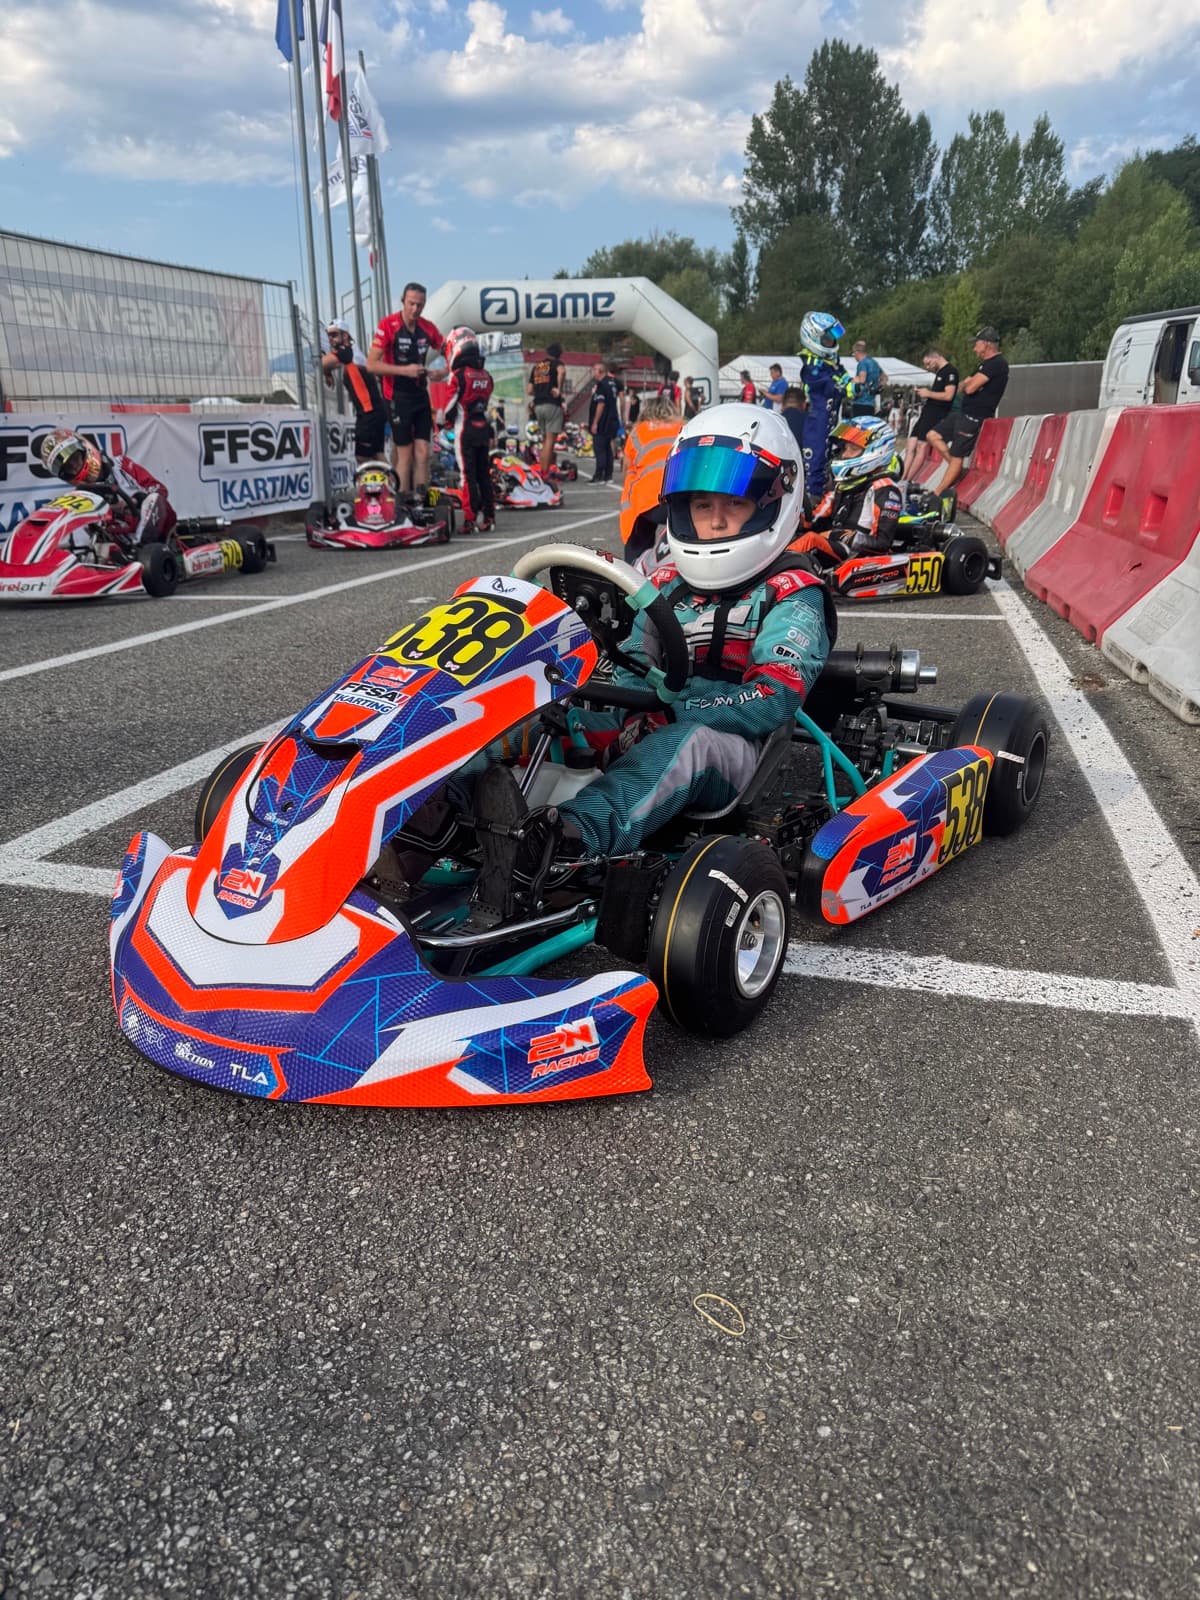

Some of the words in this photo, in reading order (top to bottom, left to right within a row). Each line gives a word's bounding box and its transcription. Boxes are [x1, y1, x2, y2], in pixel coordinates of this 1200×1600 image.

[203, 427, 303, 466] FFSA
[222, 471, 310, 505] KARTING
[0, 581, 47, 593] irelart
[906, 556, 941, 592] 550
[336, 694, 393, 713] KARTING
[340, 683, 399, 702] FFSA
[938, 759, 989, 865] 538
[256, 831, 271, 841] TLA
[221, 868, 267, 899] 2N
[217, 890, 257, 909] RACING
[527, 1016, 600, 1064] 2N
[230, 1063, 269, 1086] TLA
[531, 1048, 600, 1079] RACING
